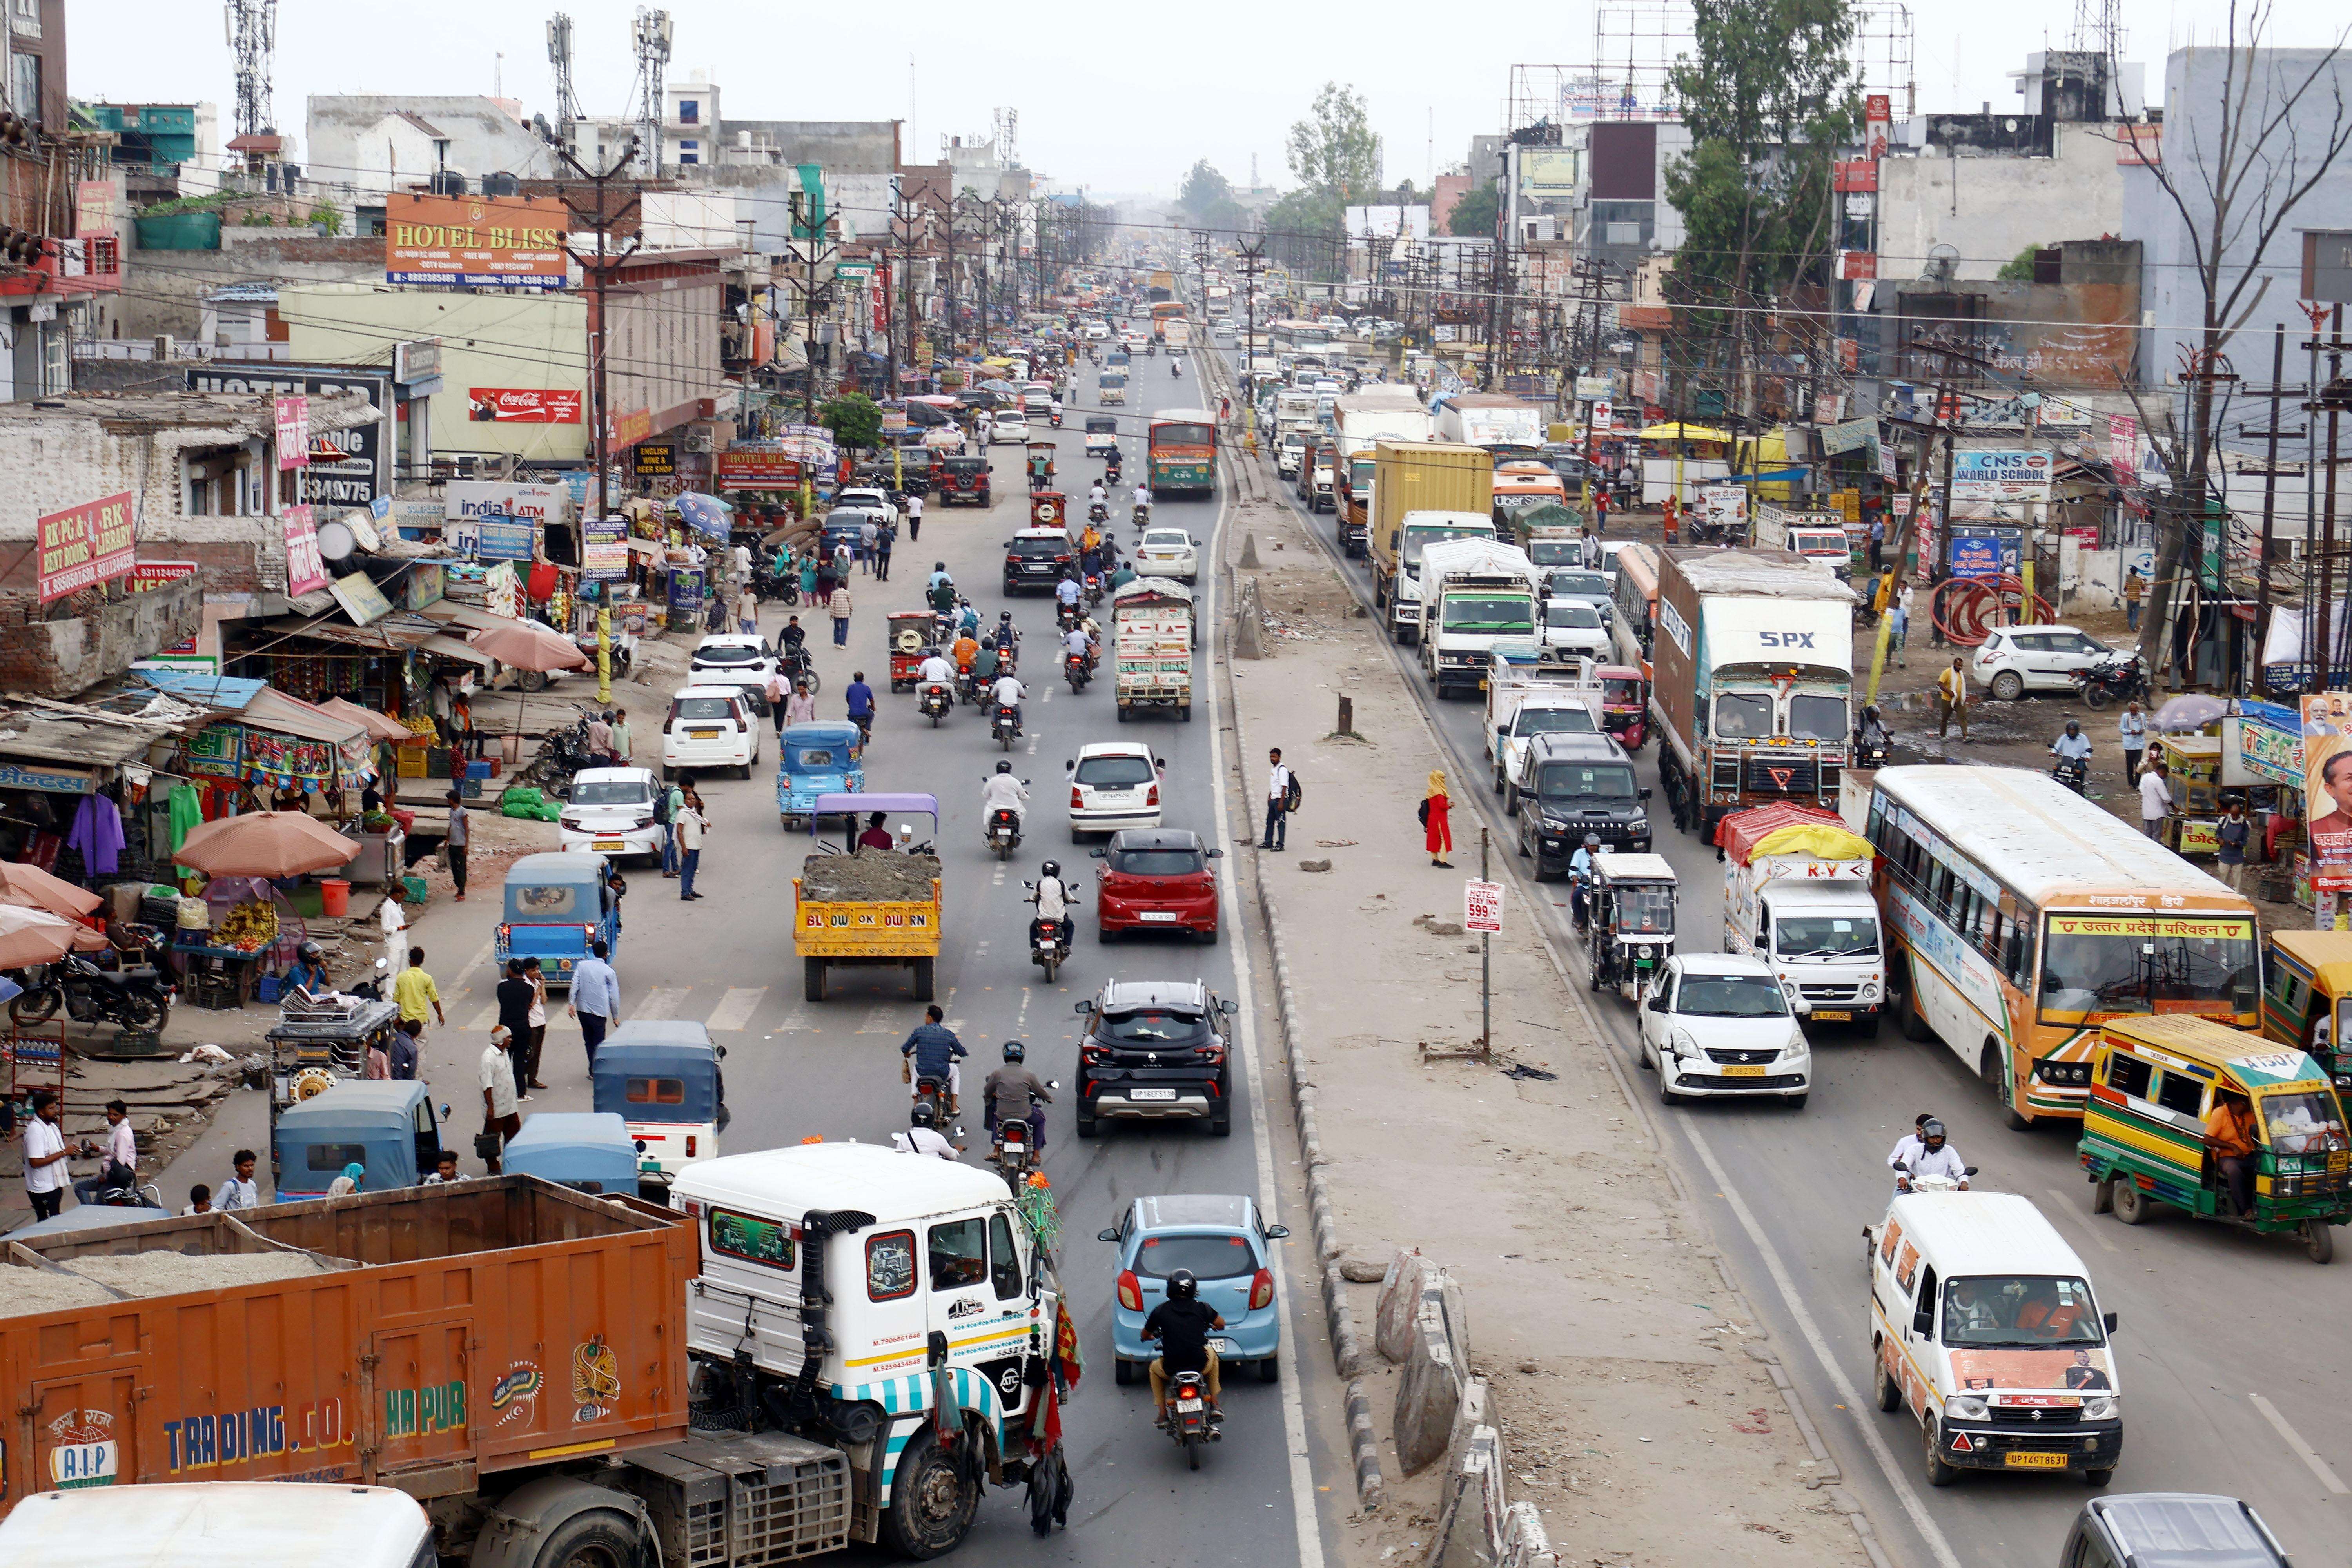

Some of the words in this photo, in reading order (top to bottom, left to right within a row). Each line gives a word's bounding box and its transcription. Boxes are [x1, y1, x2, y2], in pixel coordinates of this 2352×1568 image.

[395, 225, 482, 249] HOTEL
[490, 227, 558, 250] BLISS
[640, 447, 669, 455] ENGLISH
[730, 454, 764, 463] HOTEL
[1981, 456, 2023, 467] CNS
[1958, 470, 1998, 480] WORLD
[2001, 470, 2045, 480] SCHOOL
[1495, 496, 1524, 506] Uber
[1525, 495, 1562, 506] Shuttle
[517, 506, 545, 517] ATM
[44, 523, 60, 548] RK
[101, 502, 125, 530] RK
[96, 524, 132, 557] LIBRARY
[1760, 632, 1815, 649] SPX
[1470, 890, 1496, 899] HOTEL
[2160, 894, 2185, 907] डिपो
[807, 915, 824, 927] BL
[831, 915, 849, 927] OW
[859, 915, 875, 924] OK
[909, 915, 927, 927] RN
[2082, 921, 2121, 932] उत्तर
[2126, 919, 2161, 934] प्रदेश
[2163, 921, 2220, 936] परिवहन
[873, 1358, 921, 1372] M.9259434848
[386, 1381, 466, 1439] HAPUR
[84, 1409, 115, 1428] राजा
[2011, 1455, 2065, 1465] UP14GT8631
